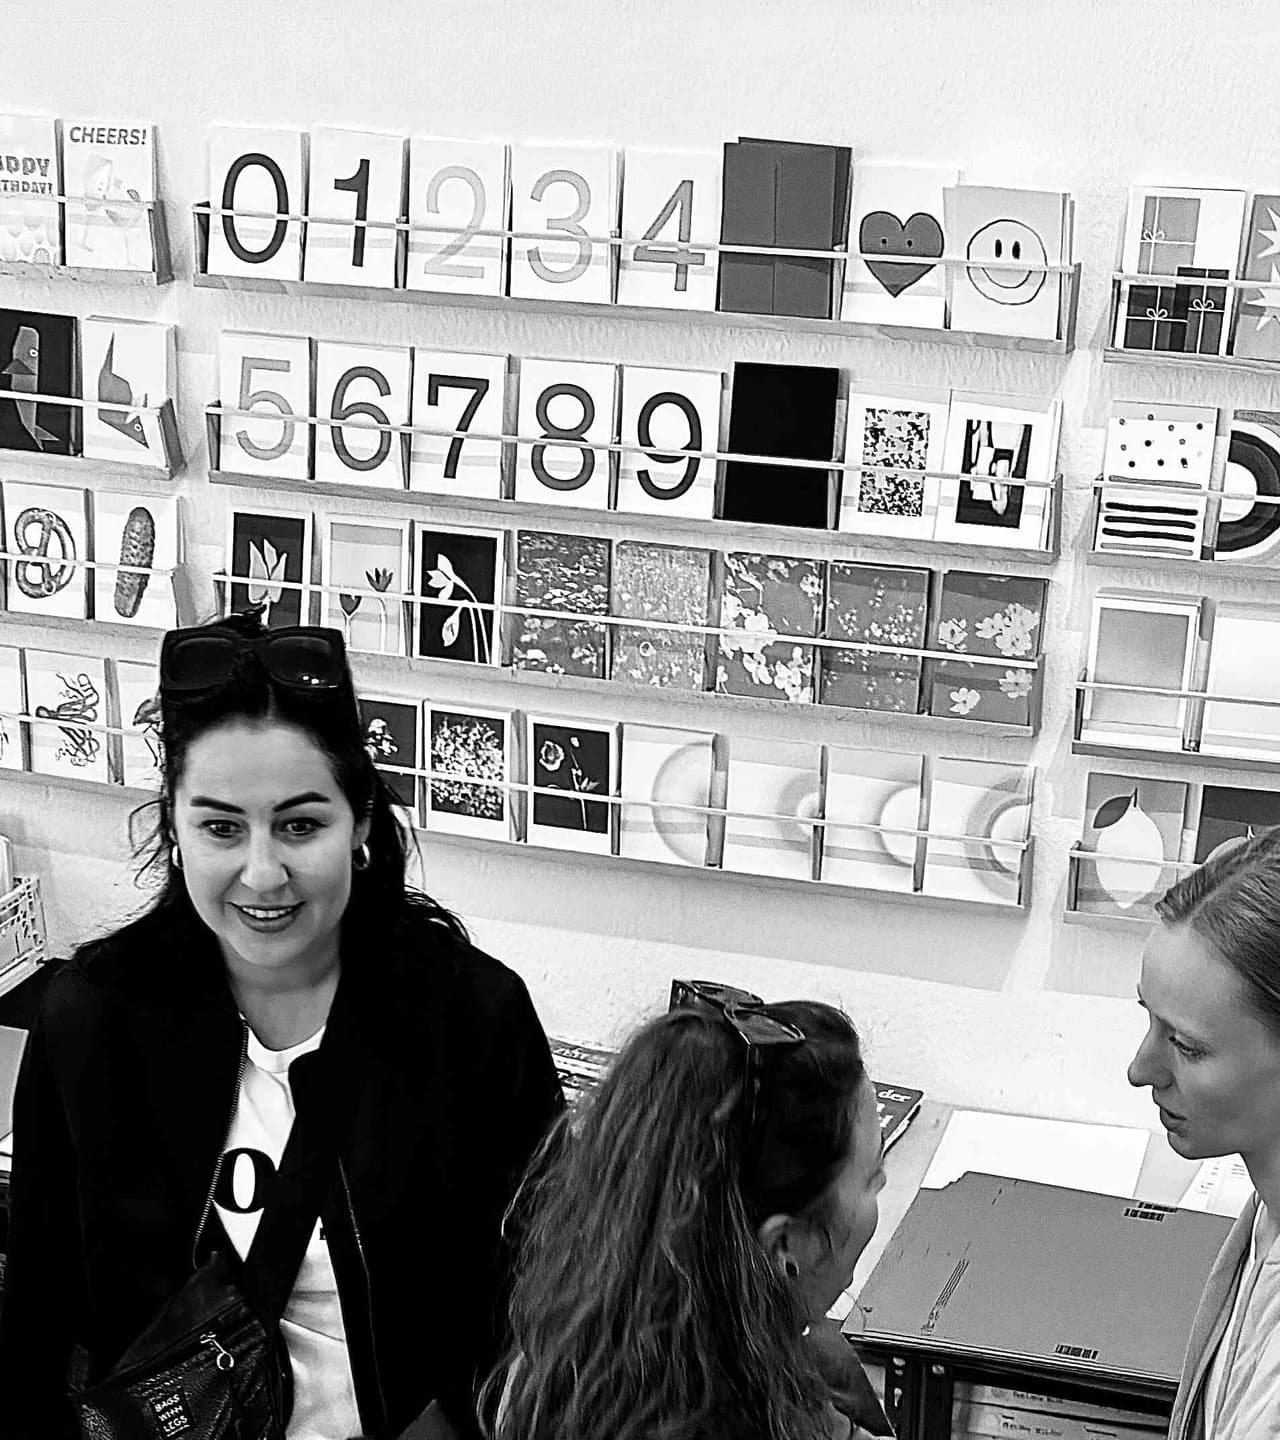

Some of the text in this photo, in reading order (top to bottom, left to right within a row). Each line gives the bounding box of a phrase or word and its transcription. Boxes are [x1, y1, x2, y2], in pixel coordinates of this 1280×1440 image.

[69, 126, 147, 145] CHEERS!
[222, 152, 289, 264] 0
[334, 158, 370, 268] 1
[424, 165, 486, 279] 2
[526, 169, 593, 284] 3
[633, 179, 705, 292] 4
[236, 356, 295, 461] 5
[330, 366, 392, 471] 6
[428, 373, 490, 479] 7
[531, 383, 596, 491] 8
[636, 391, 702, 500] 9
[154, 1394, 180, 1412] BAGS
[158, 1405, 183, 1421] WITH
[163, 1415, 188, 1432] LEGS
